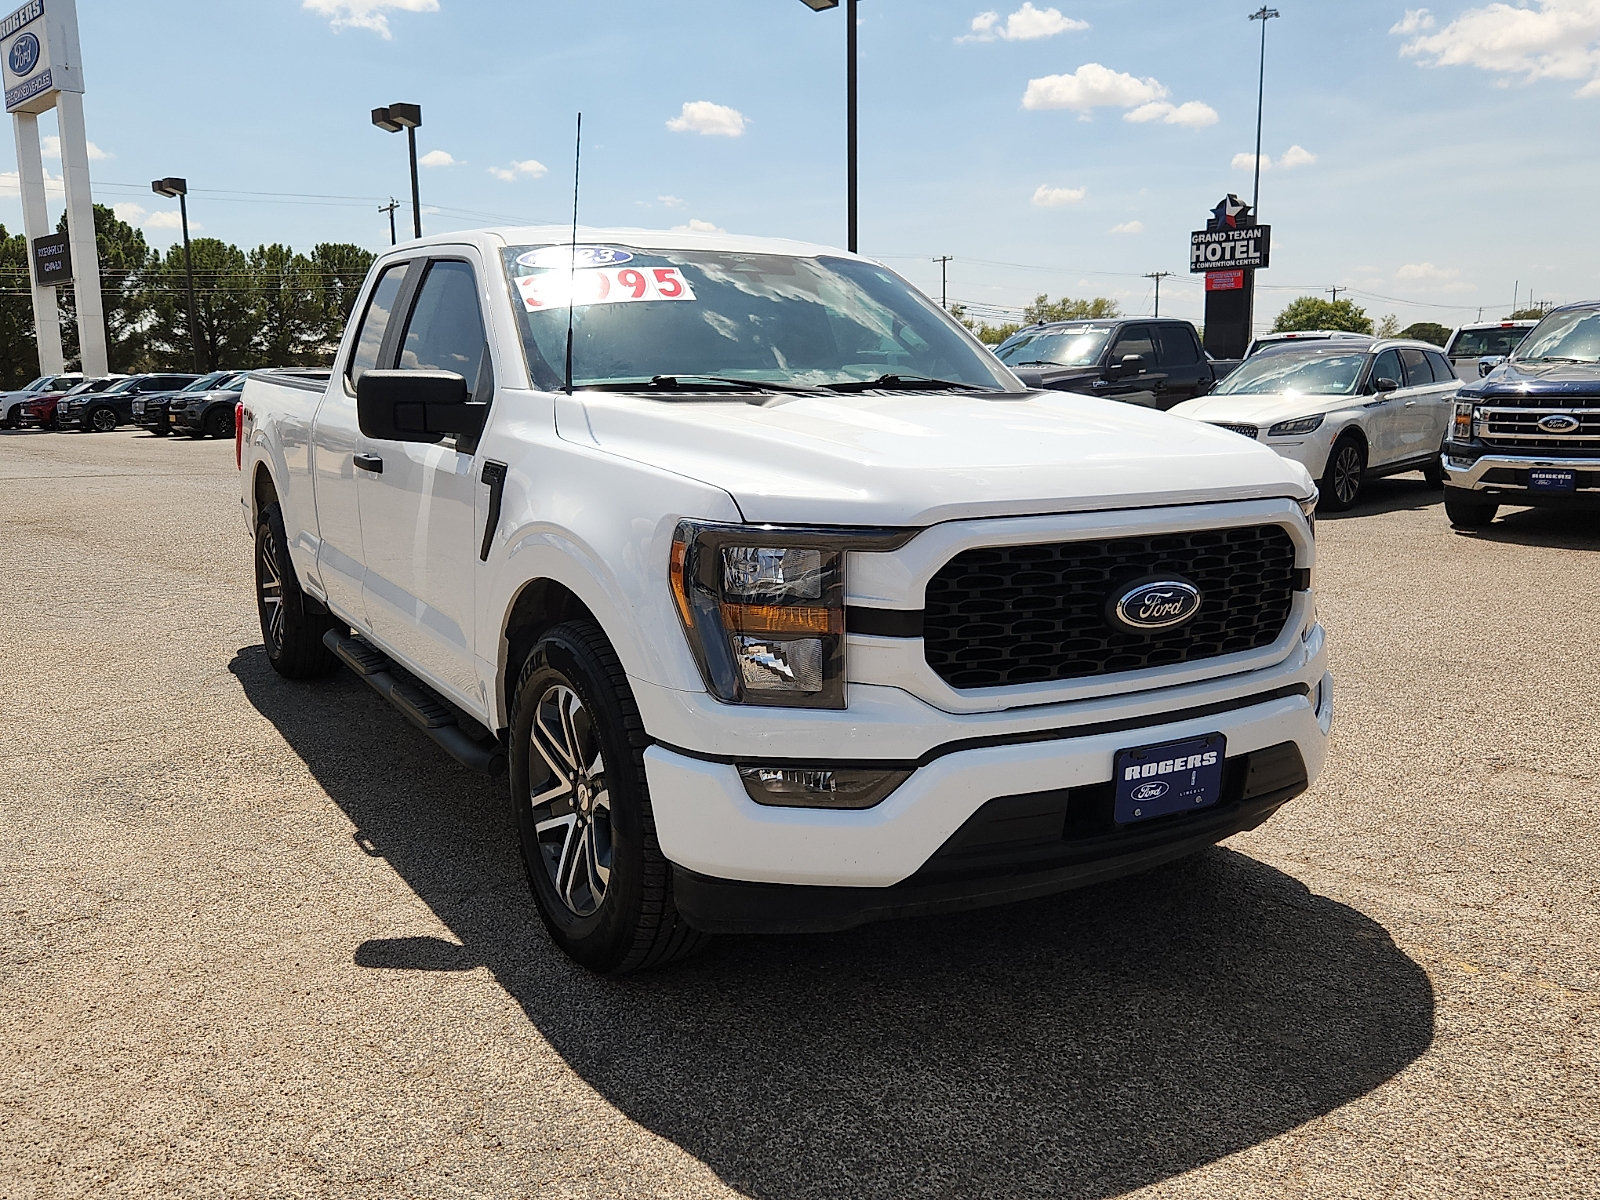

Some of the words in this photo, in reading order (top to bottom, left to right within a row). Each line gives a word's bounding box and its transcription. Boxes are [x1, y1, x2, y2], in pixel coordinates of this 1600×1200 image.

[0, 1, 40, 38] ROGERS
[1191, 232, 1226, 244] GRAND
[1228, 228, 1262, 240] TEXAN
[1191, 239, 1260, 263] HOTEL
[1196, 259, 1235, 269] CONVENTION
[1236, 258, 1260, 266] CENTER
[1547, 419, 1567, 428] Ford
[1139, 591, 1185, 619] Ford
[1124, 751, 1218, 781] ROGERS
[1137, 783, 1163, 799] Ford
[1179, 787, 1205, 797] LINCOLN
